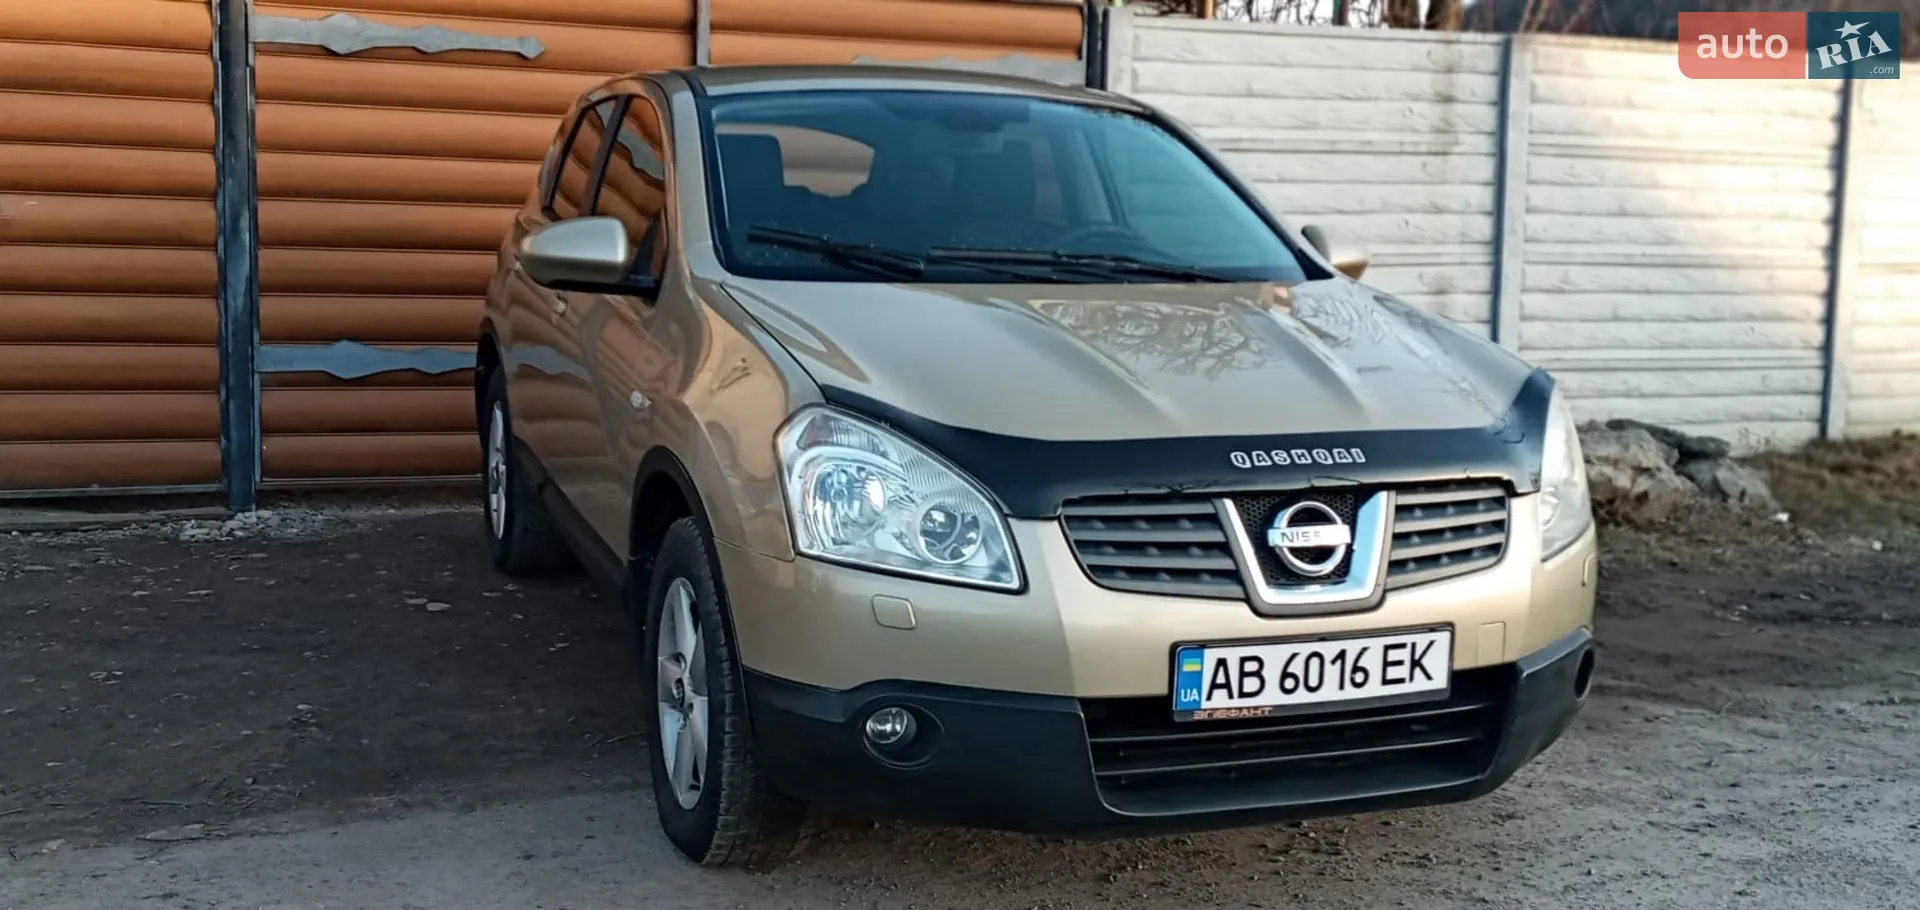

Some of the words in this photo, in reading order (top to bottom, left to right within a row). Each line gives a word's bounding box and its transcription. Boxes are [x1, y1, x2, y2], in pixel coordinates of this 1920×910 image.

[1229, 448, 1366, 469] QASHQAI
[1281, 530, 1323, 544] NISS
[1205, 655, 1266, 701] AB
[1279, 646, 1371, 696] 6016
[1380, 639, 1437, 687] EK
[1180, 688, 1199, 703] UA
